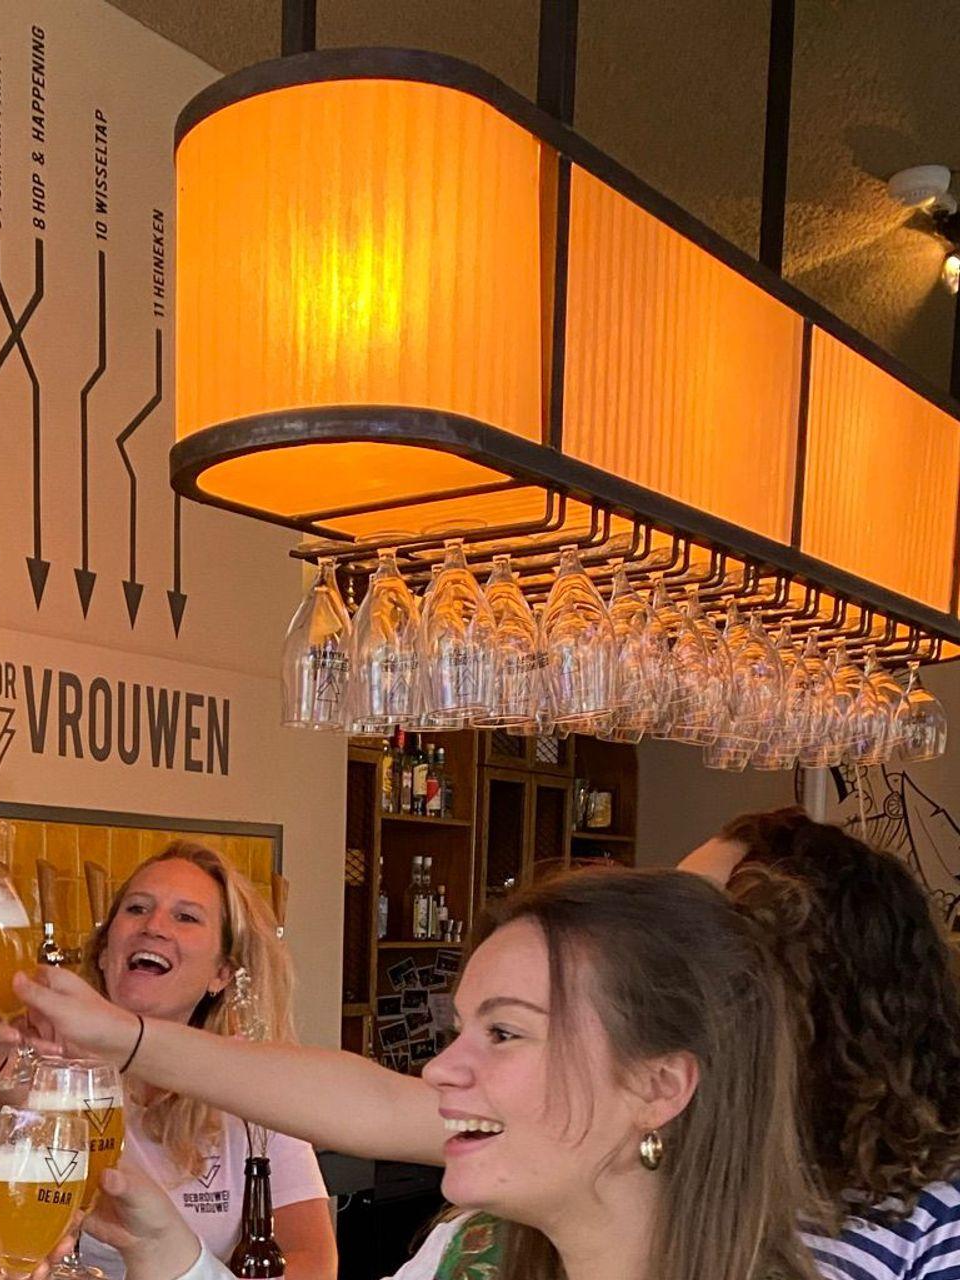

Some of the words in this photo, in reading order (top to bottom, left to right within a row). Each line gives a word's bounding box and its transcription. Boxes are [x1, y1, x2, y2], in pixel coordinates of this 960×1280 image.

[31, 25, 46, 143] HAPPENING
[32, 151, 46, 166] &
[95, 109, 108, 214] WISSELTAP
[32, 173, 46, 214] HOP
[32, 216, 46, 230] 8
[96, 221, 108, 241] 10
[152, 209, 165, 298] HEINEKEN
[154, 303, 165, 317] 11
[23, 665, 230, 776] VROUWEN
[37, 1188, 51, 1204] DE
[53, 1190, 73, 1206] BAR
